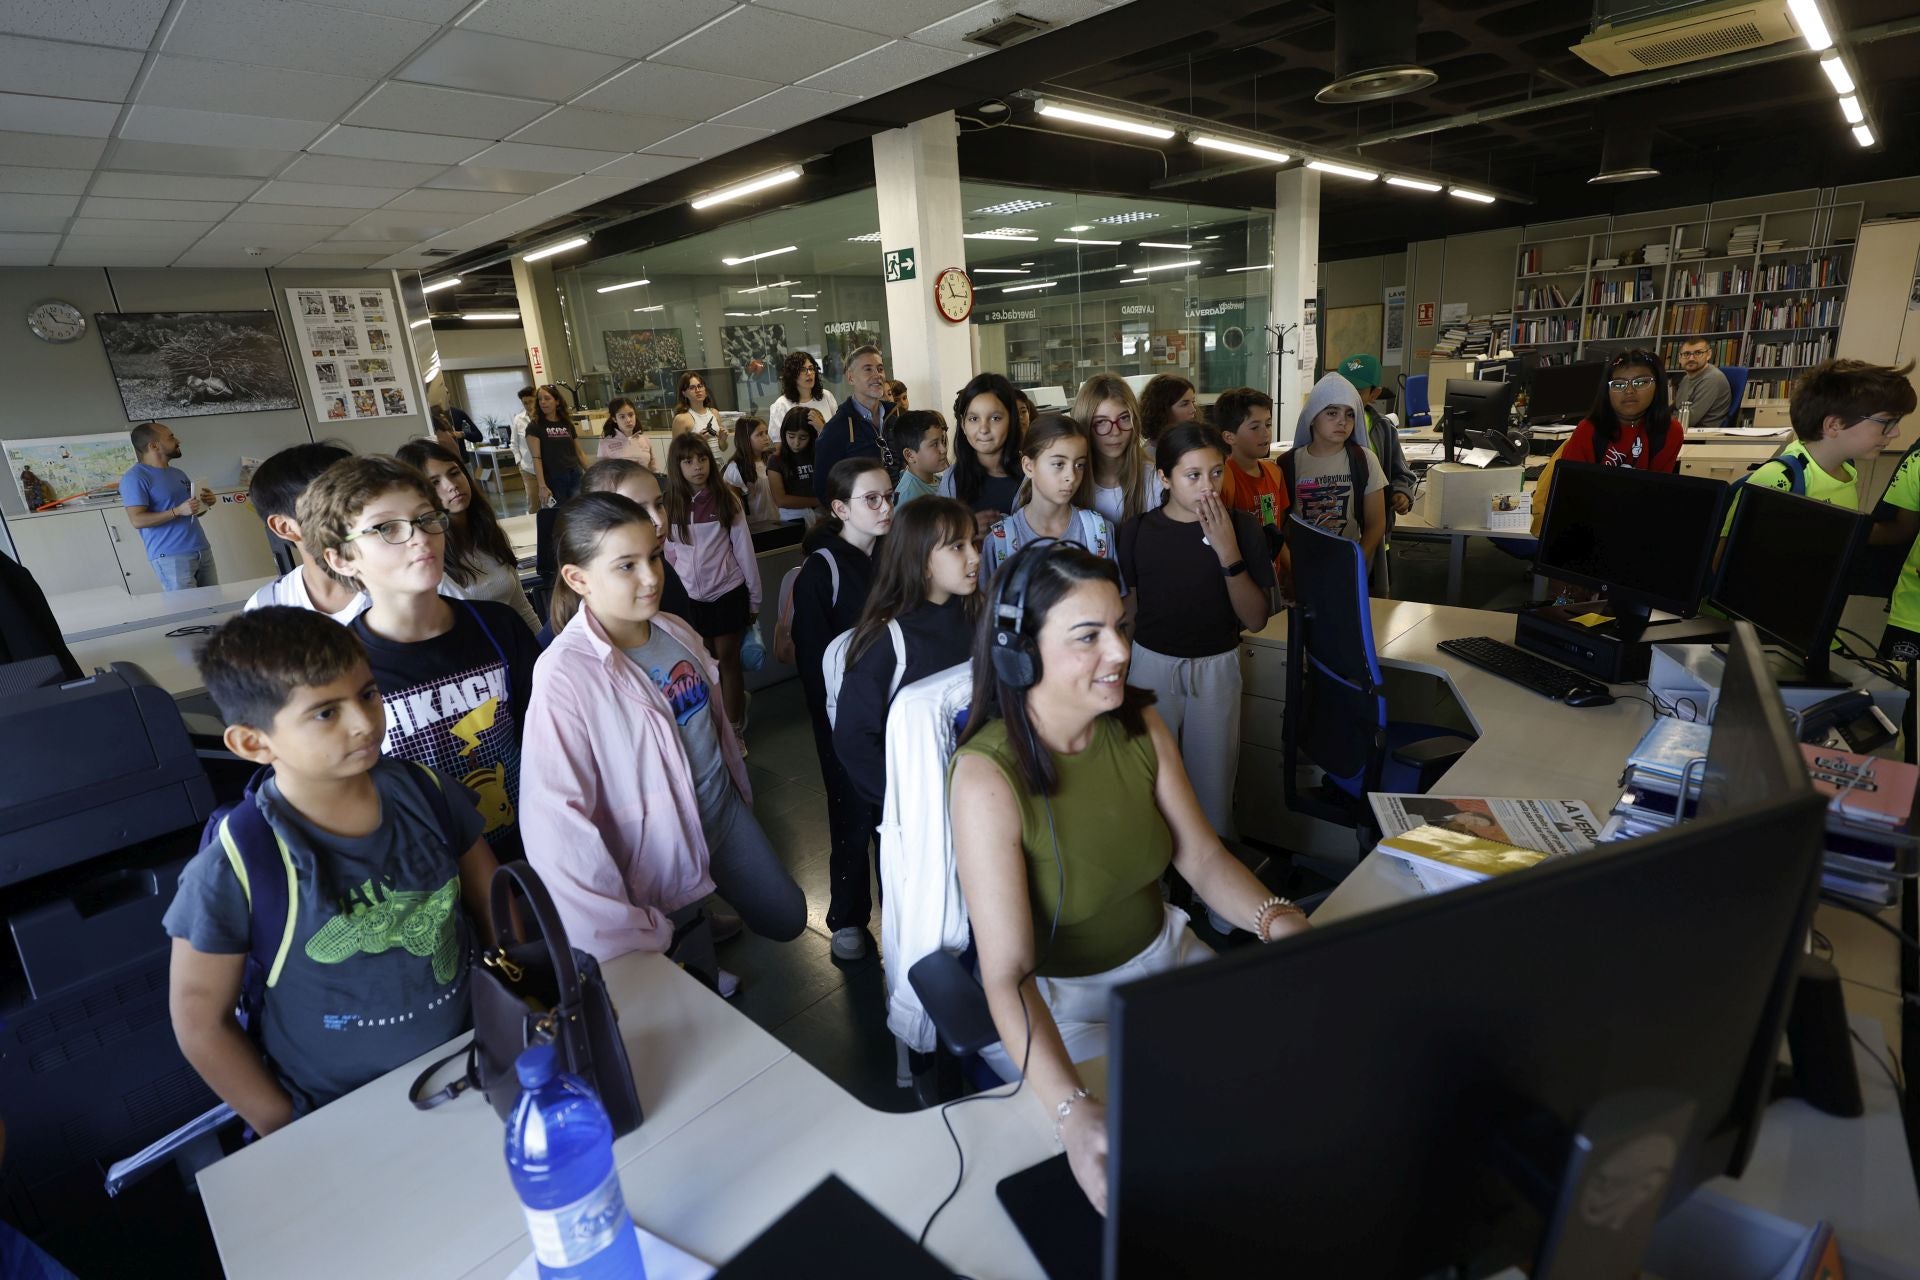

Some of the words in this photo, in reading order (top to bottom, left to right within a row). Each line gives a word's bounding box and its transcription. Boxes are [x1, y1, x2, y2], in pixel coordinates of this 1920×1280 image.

[1185, 309, 1195, 317] LA
[1196, 306, 1226, 317] VERDAD
[1560, 800, 1580, 814] LA
[357, 1011, 414, 1027] GAMERS
